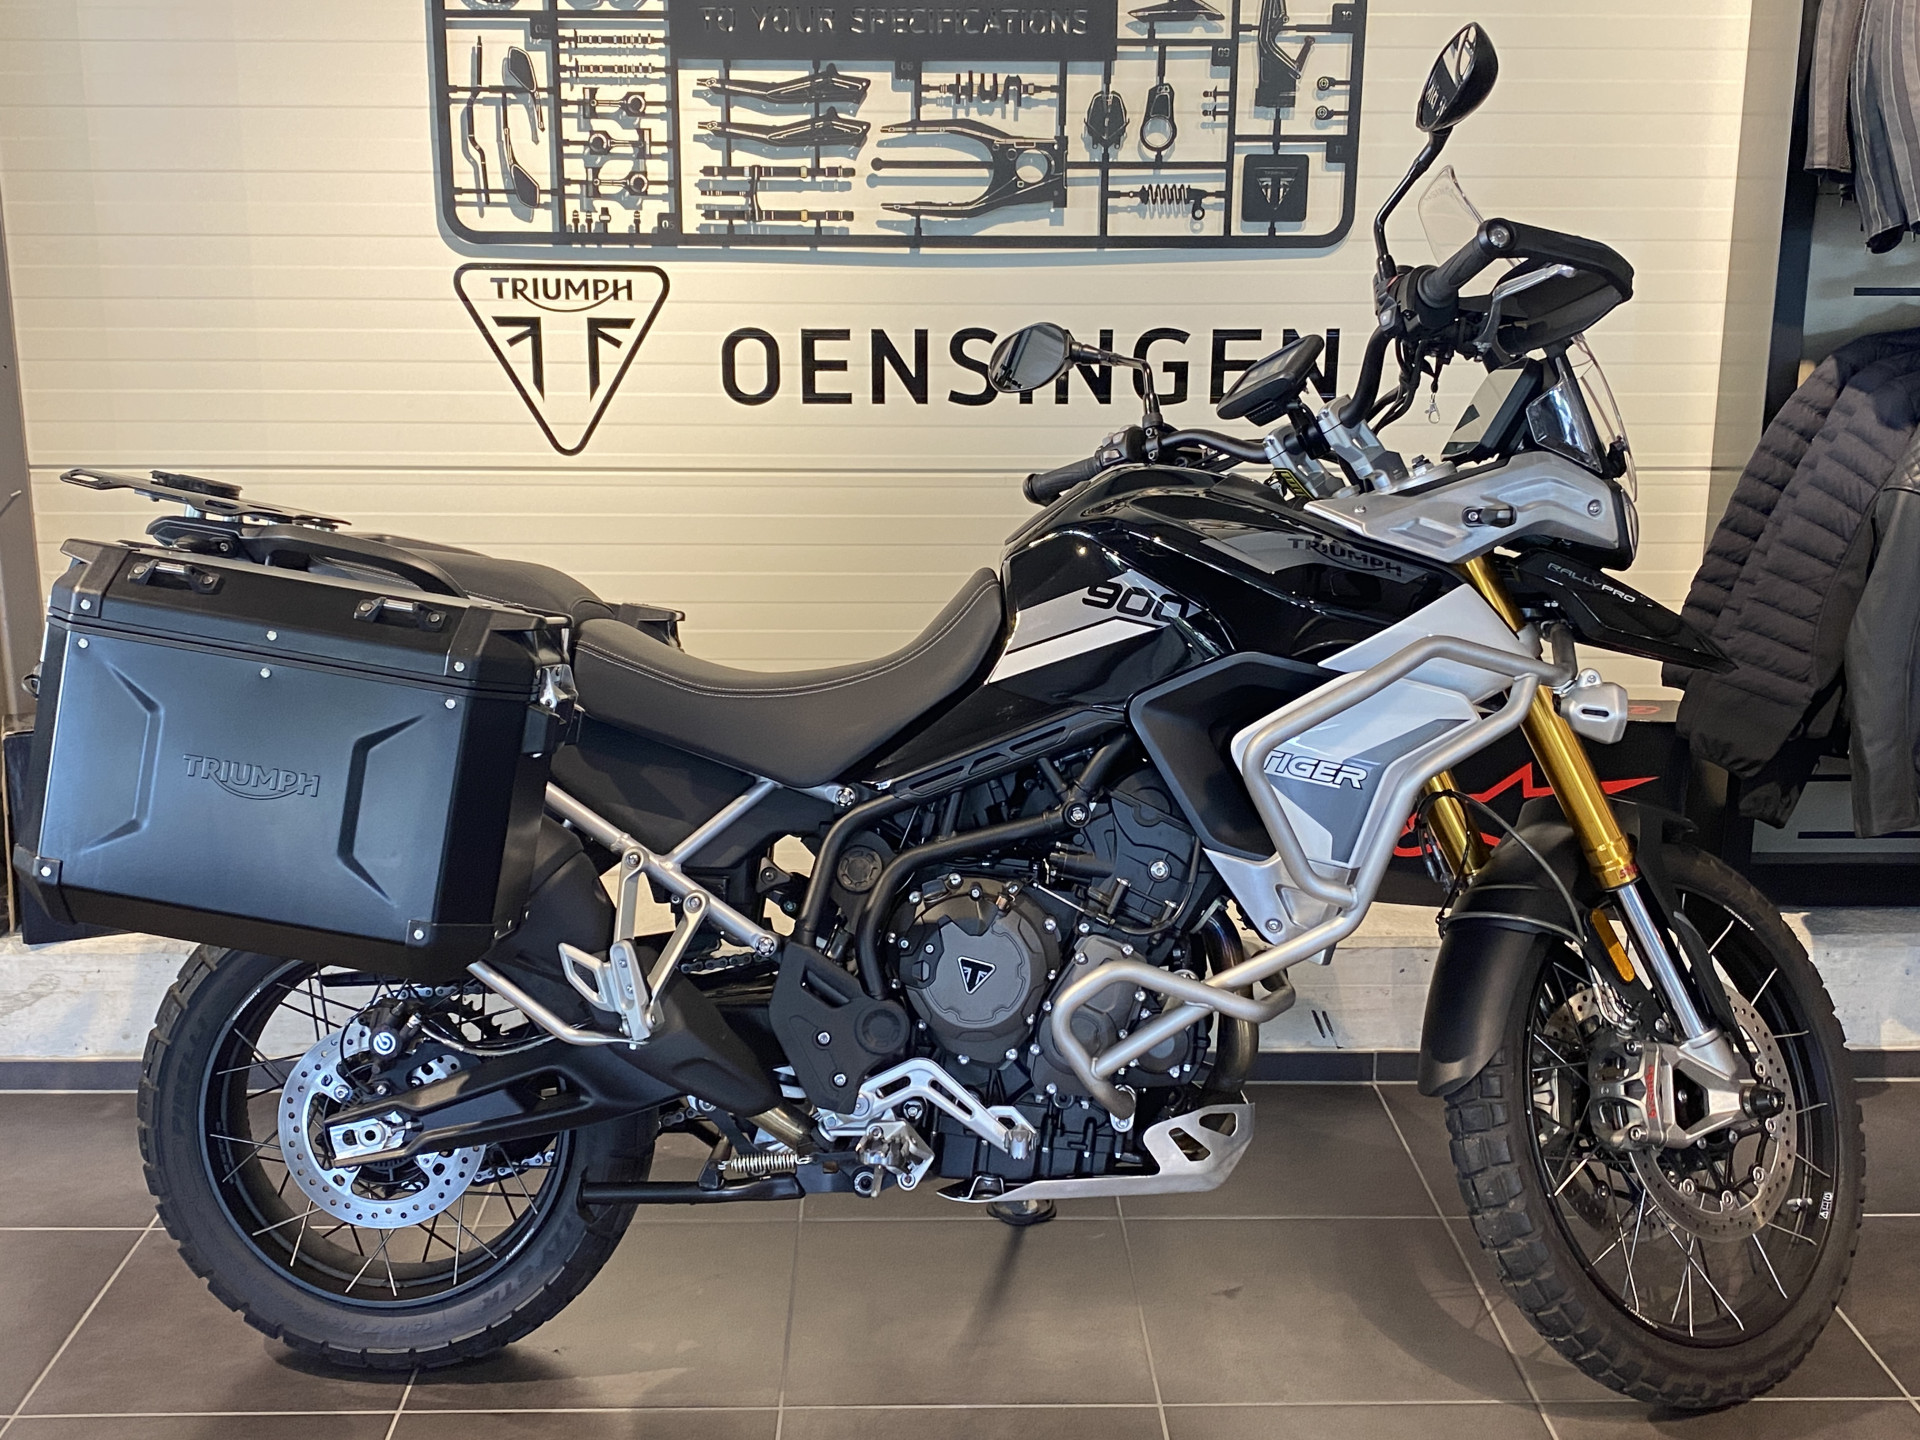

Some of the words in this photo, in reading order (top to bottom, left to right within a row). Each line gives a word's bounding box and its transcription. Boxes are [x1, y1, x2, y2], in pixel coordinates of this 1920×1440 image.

[700, 6, 736, 33] TO
[751, 6, 837, 34] YOUR
[850, 7, 1089, 35] SPECIFICATIONS
[490, 277, 633, 312] TRIUMPH
[721, 327, 1341, 405] OENSNGEN
[1287, 537, 1402, 577] TRIUMPH
[1082, 581, 1191, 623] 900
[183, 754, 320, 800] TRIUMPH
[1264, 750, 1369, 790] TIGER
